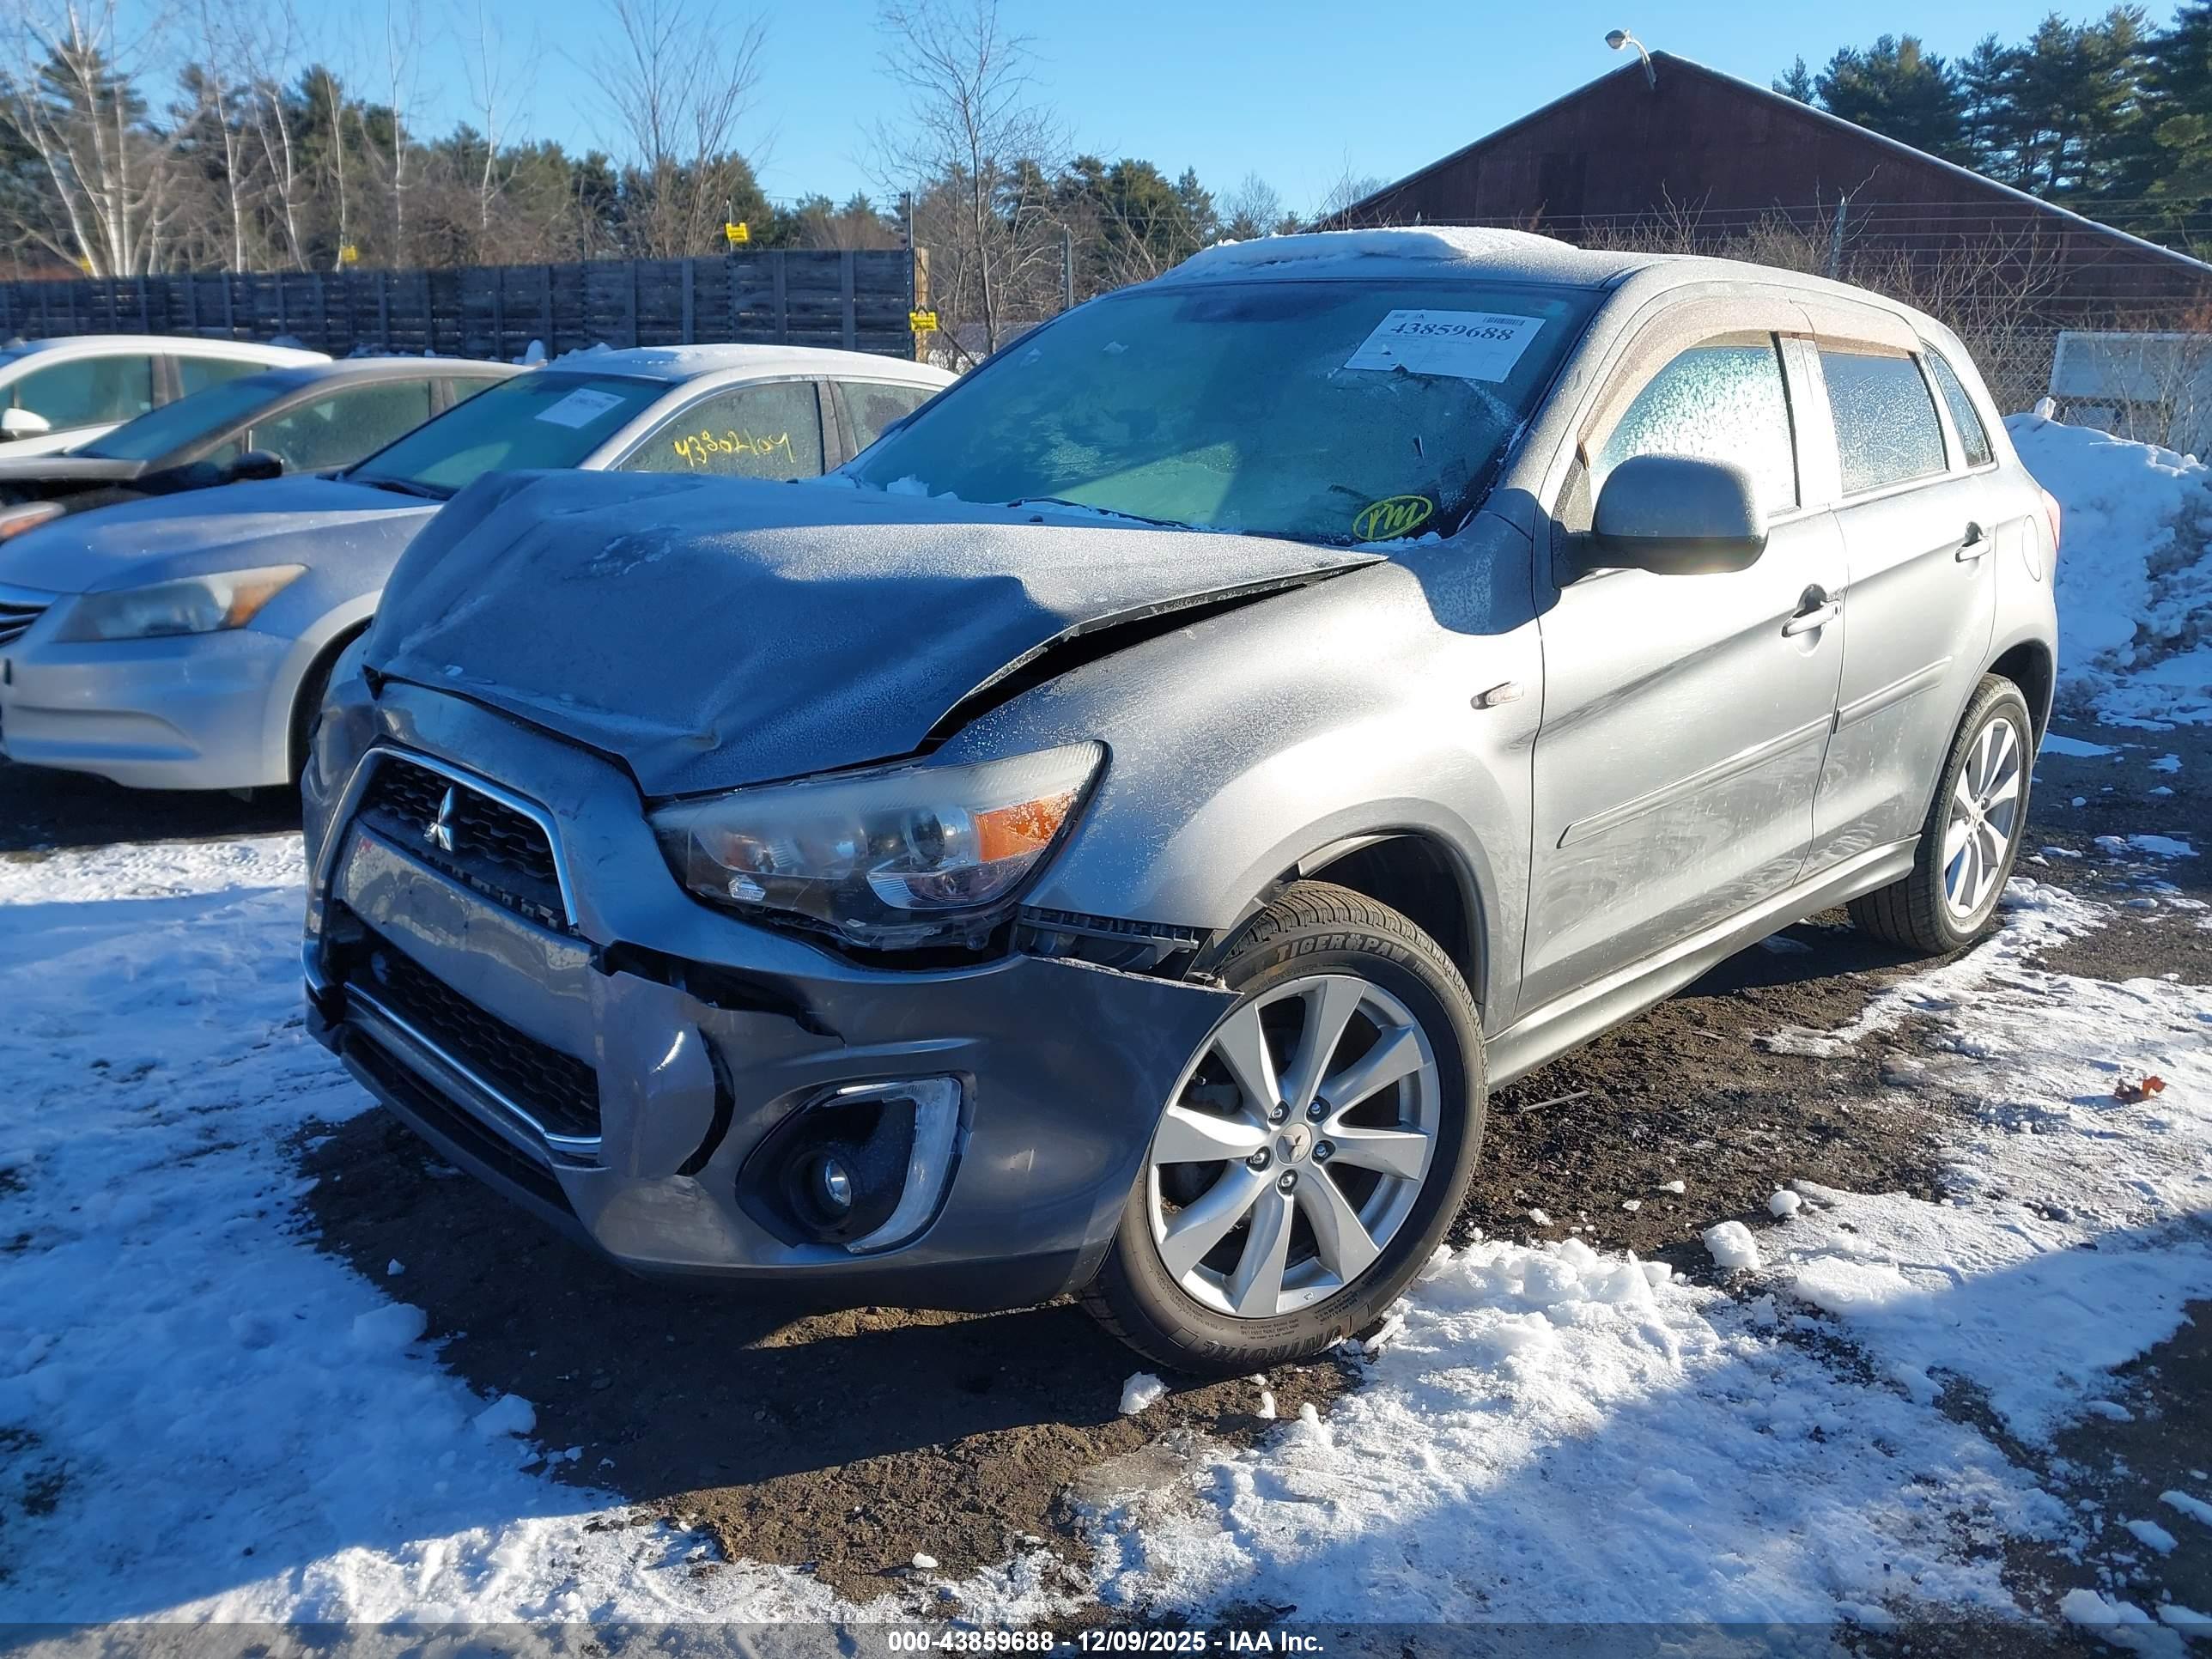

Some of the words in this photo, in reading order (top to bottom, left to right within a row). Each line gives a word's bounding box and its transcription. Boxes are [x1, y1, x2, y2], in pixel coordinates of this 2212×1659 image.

[1389, 321, 1515, 342] 43859688
[1276, 933, 1346, 963] TIGER
[1364, 936, 1410, 963] PAW
